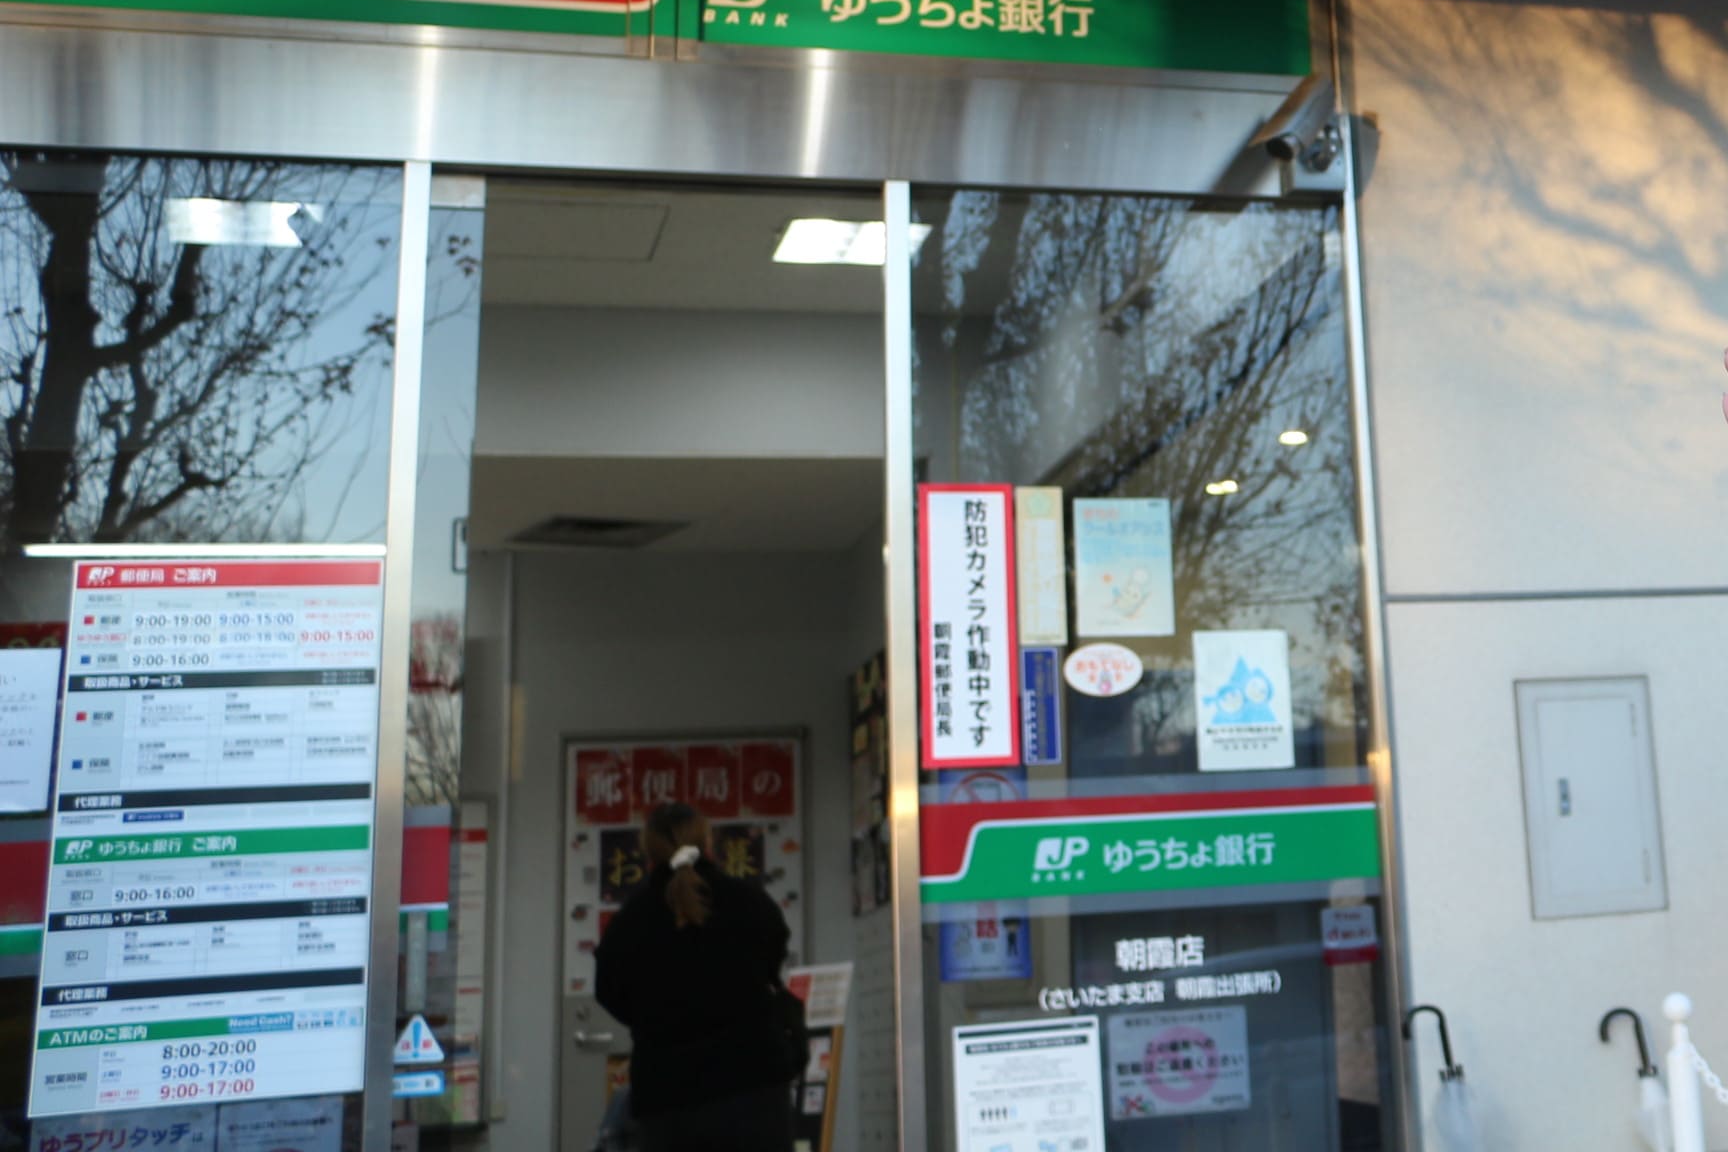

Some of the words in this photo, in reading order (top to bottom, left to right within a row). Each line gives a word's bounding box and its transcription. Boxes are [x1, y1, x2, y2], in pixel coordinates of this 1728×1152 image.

[703, 9, 789, 27] BANK
[120, 568, 164, 583] 郵便局
[173, 568, 217, 583] ご案内
[135, 615, 212, 626] 9:00-19:00
[219, 613, 294, 625] 9:00-15:00
[964, 500, 992, 748] 防犯カメラ作動中です
[301, 630, 374, 641] 9:00-15:00
[132, 654, 209, 666] 9:00-16:00
[586, 764, 781, 807] 郵便局の
[98, 837, 181, 855] ゆうちょ銀行
[192, 836, 237, 852] ご案内
[1103, 833, 1275, 873] ゆうちょ銀行
[115, 886, 195, 902] 9:00-16:00
[65, 910, 168, 927] 取扱商品・サービス
[1115, 934, 1204, 972] 朝霞店
[50, 1024, 148, 1047] ATMのご案内
[162, 1038, 257, 1061] 8:00-20:00
[161, 1058, 256, 1080] 9:00-17:00
[160, 1078, 255, 1100] 9:00-17:00
